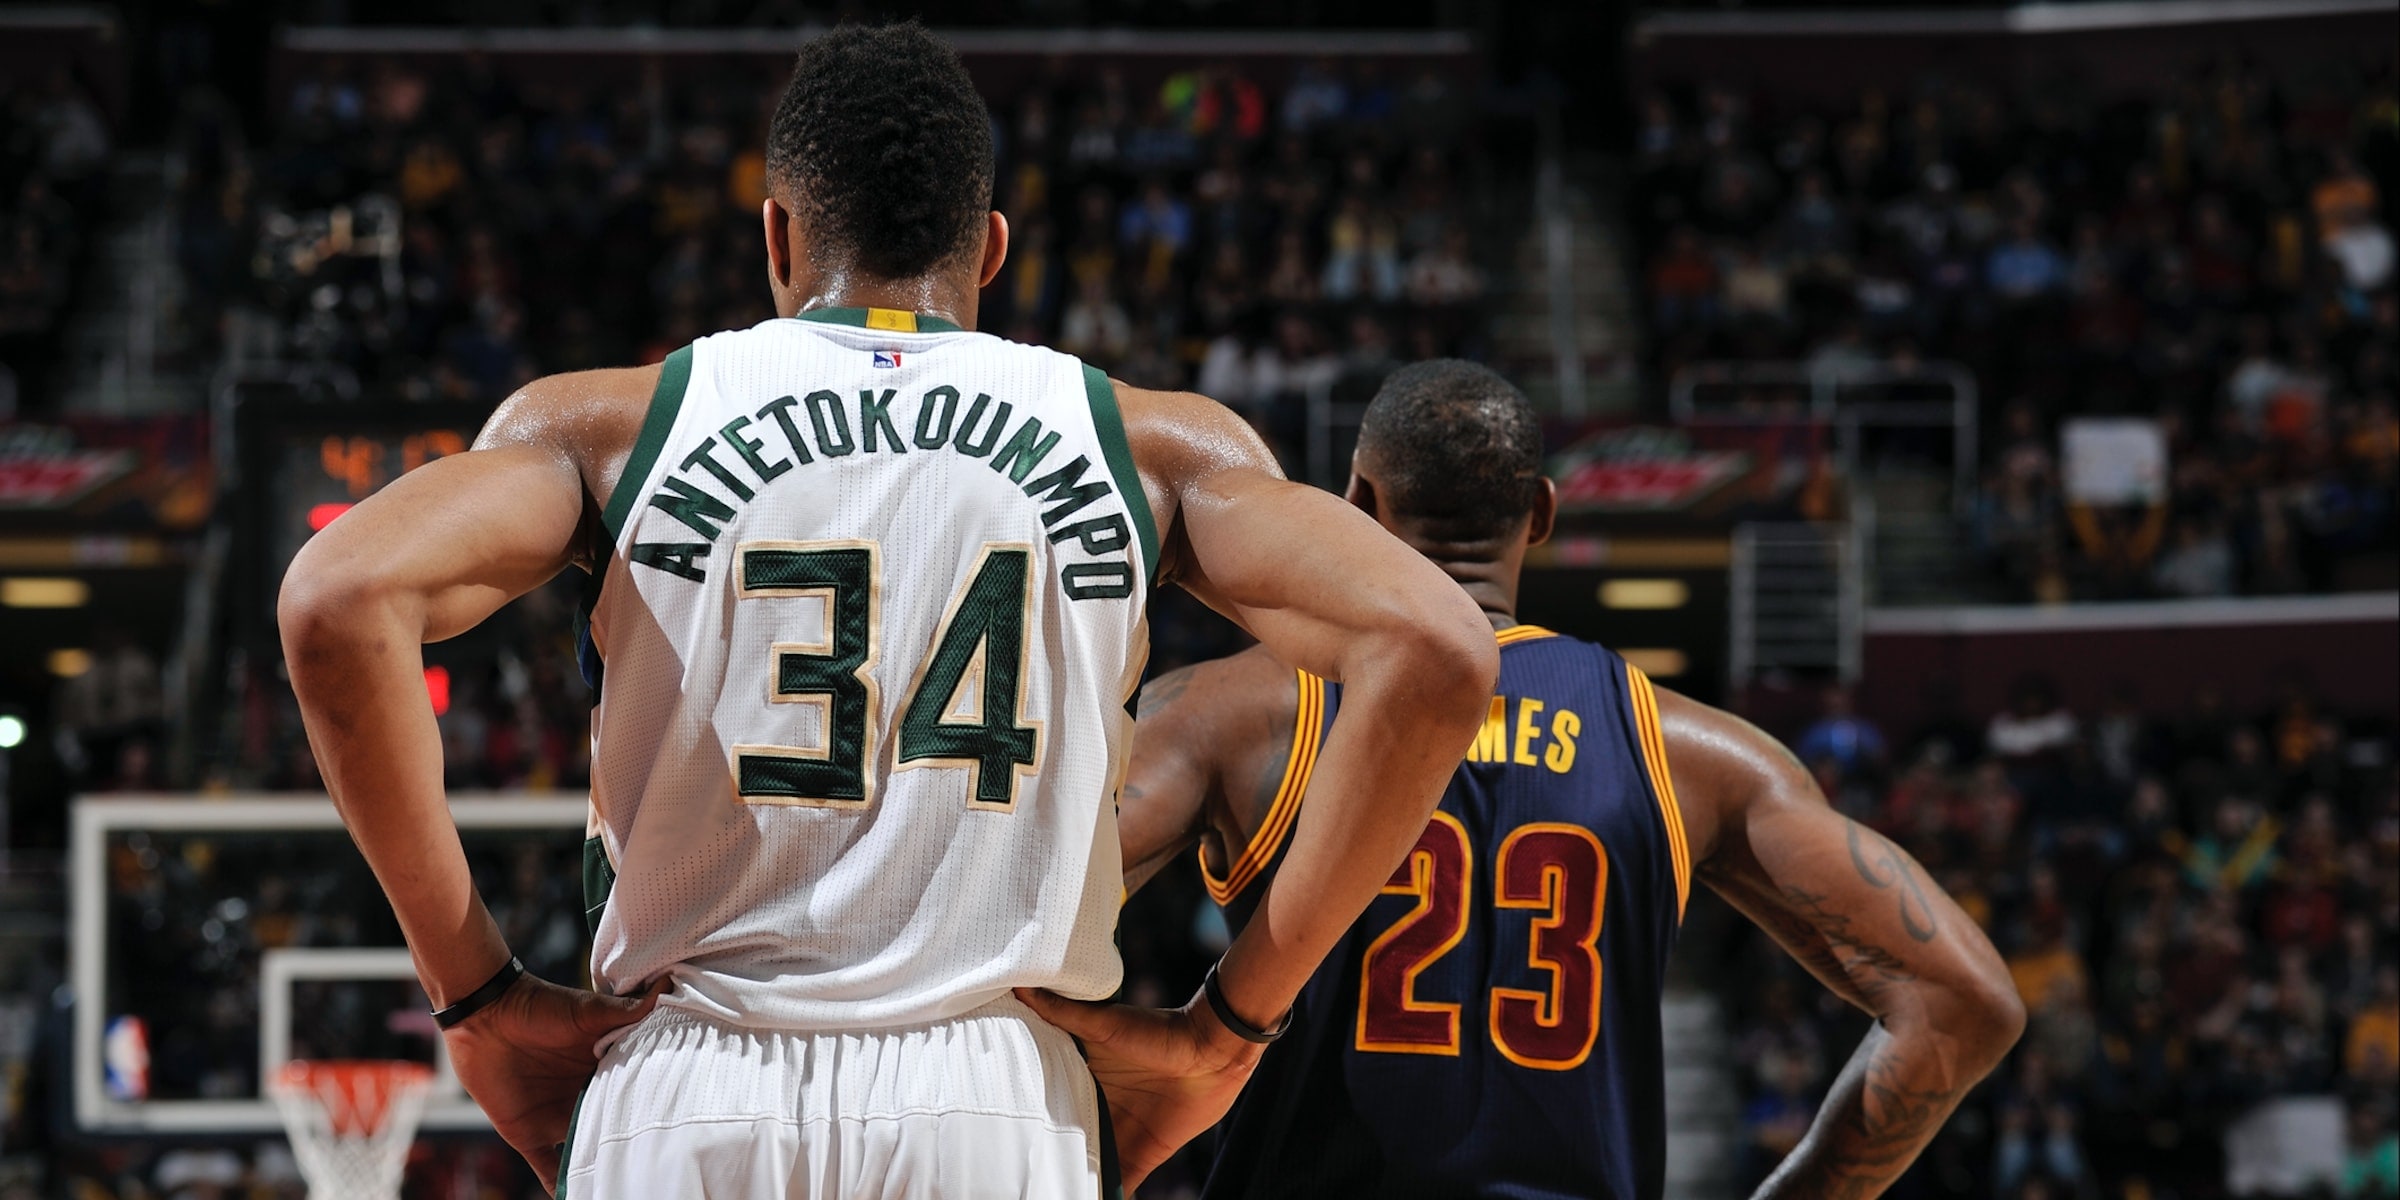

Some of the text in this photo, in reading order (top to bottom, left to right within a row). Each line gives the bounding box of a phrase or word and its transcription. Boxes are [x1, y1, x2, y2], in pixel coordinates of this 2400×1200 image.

[630, 385, 1133, 602] ANTETOKOUNMPO
[733, 540, 1043, 814] 34
[1466, 695, 1580, 774] MES
[1356, 811, 1608, 1070] 23
